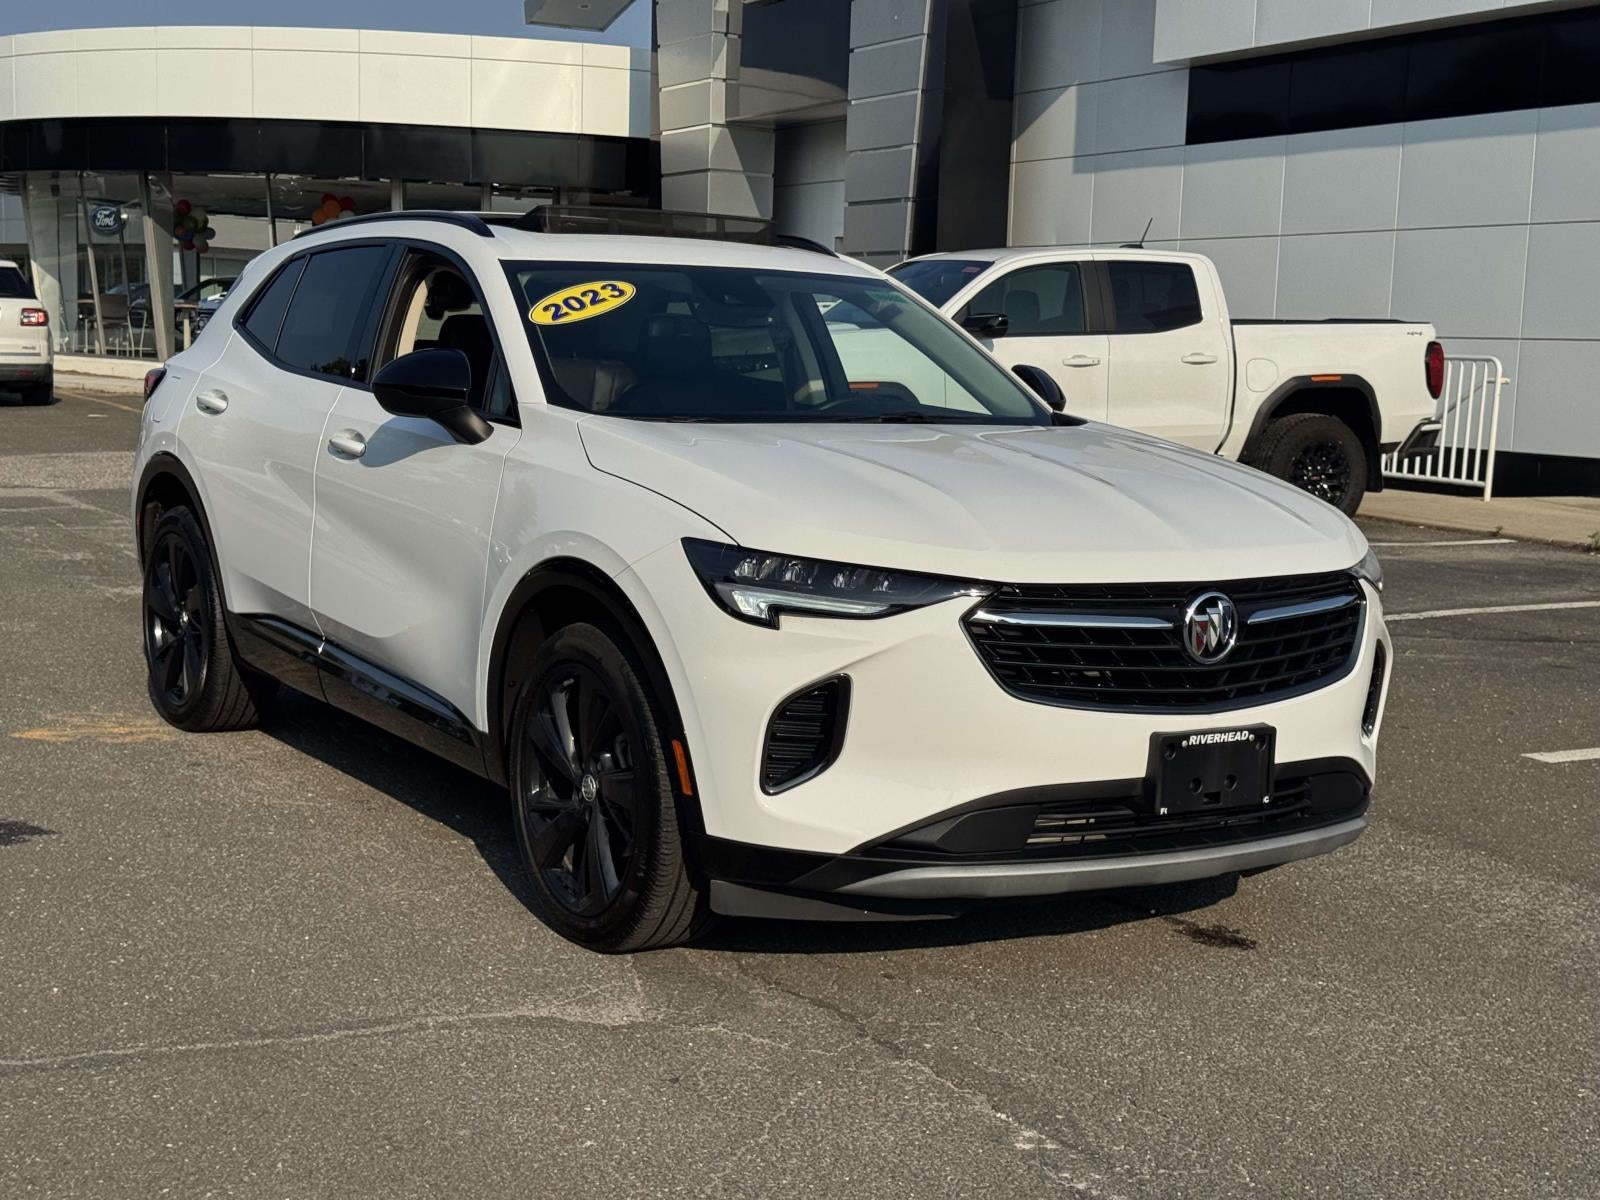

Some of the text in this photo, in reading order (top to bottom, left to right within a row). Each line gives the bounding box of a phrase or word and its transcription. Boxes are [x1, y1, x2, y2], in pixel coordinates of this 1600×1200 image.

[95, 210, 116, 227] Ford
[542, 283, 627, 321] 2023
[1189, 730, 1249, 746] RIVERHEAD
